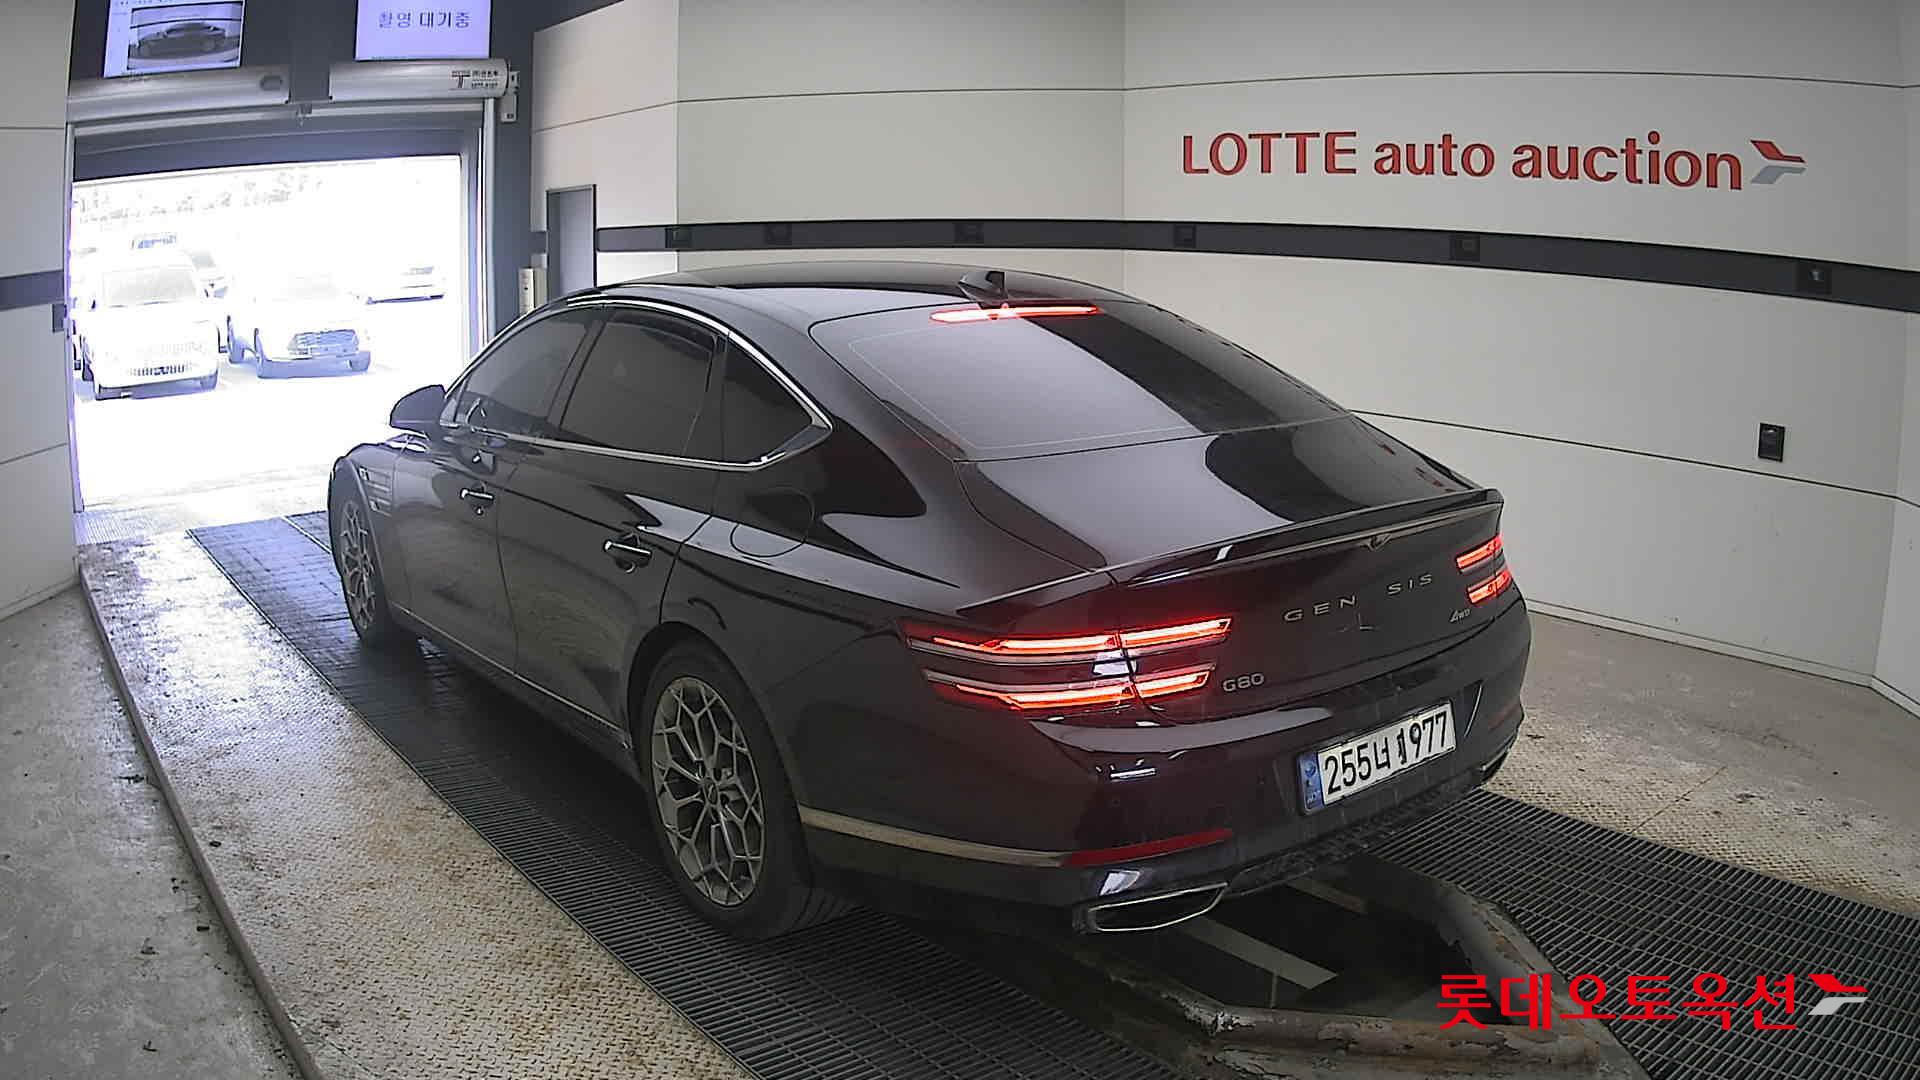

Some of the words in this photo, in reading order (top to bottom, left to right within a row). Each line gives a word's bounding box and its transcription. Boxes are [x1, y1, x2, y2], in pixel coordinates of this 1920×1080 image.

[1184, 131, 1357, 175] LOTTE
[1373, 134, 1496, 177] auto
[1511, 131, 1744, 190] auction
[1222, 673, 1266, 694] G80
